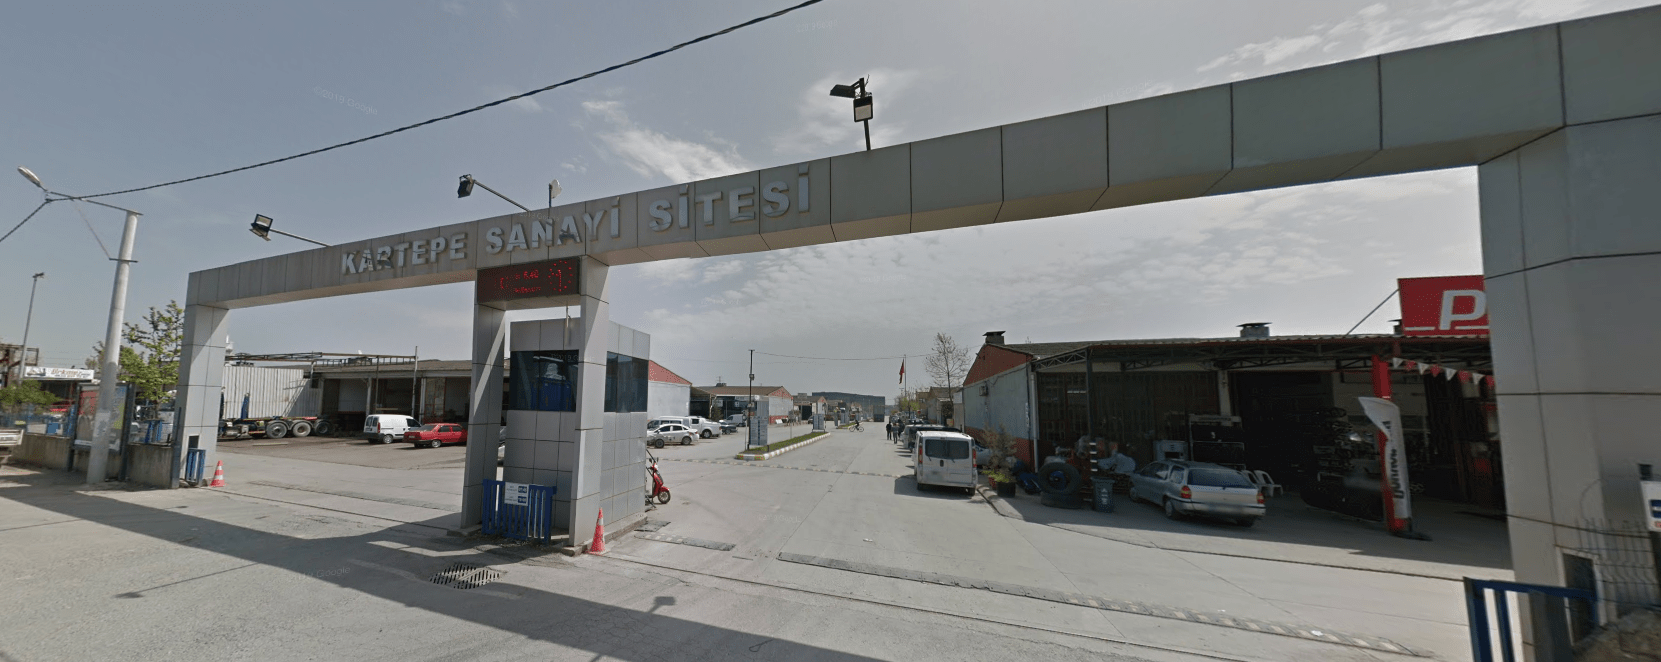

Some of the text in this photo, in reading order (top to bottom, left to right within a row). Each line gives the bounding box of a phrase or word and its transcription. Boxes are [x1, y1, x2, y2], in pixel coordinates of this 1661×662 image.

[341, 162, 810, 275] KARTEPE SANAYİ SİTESİ
